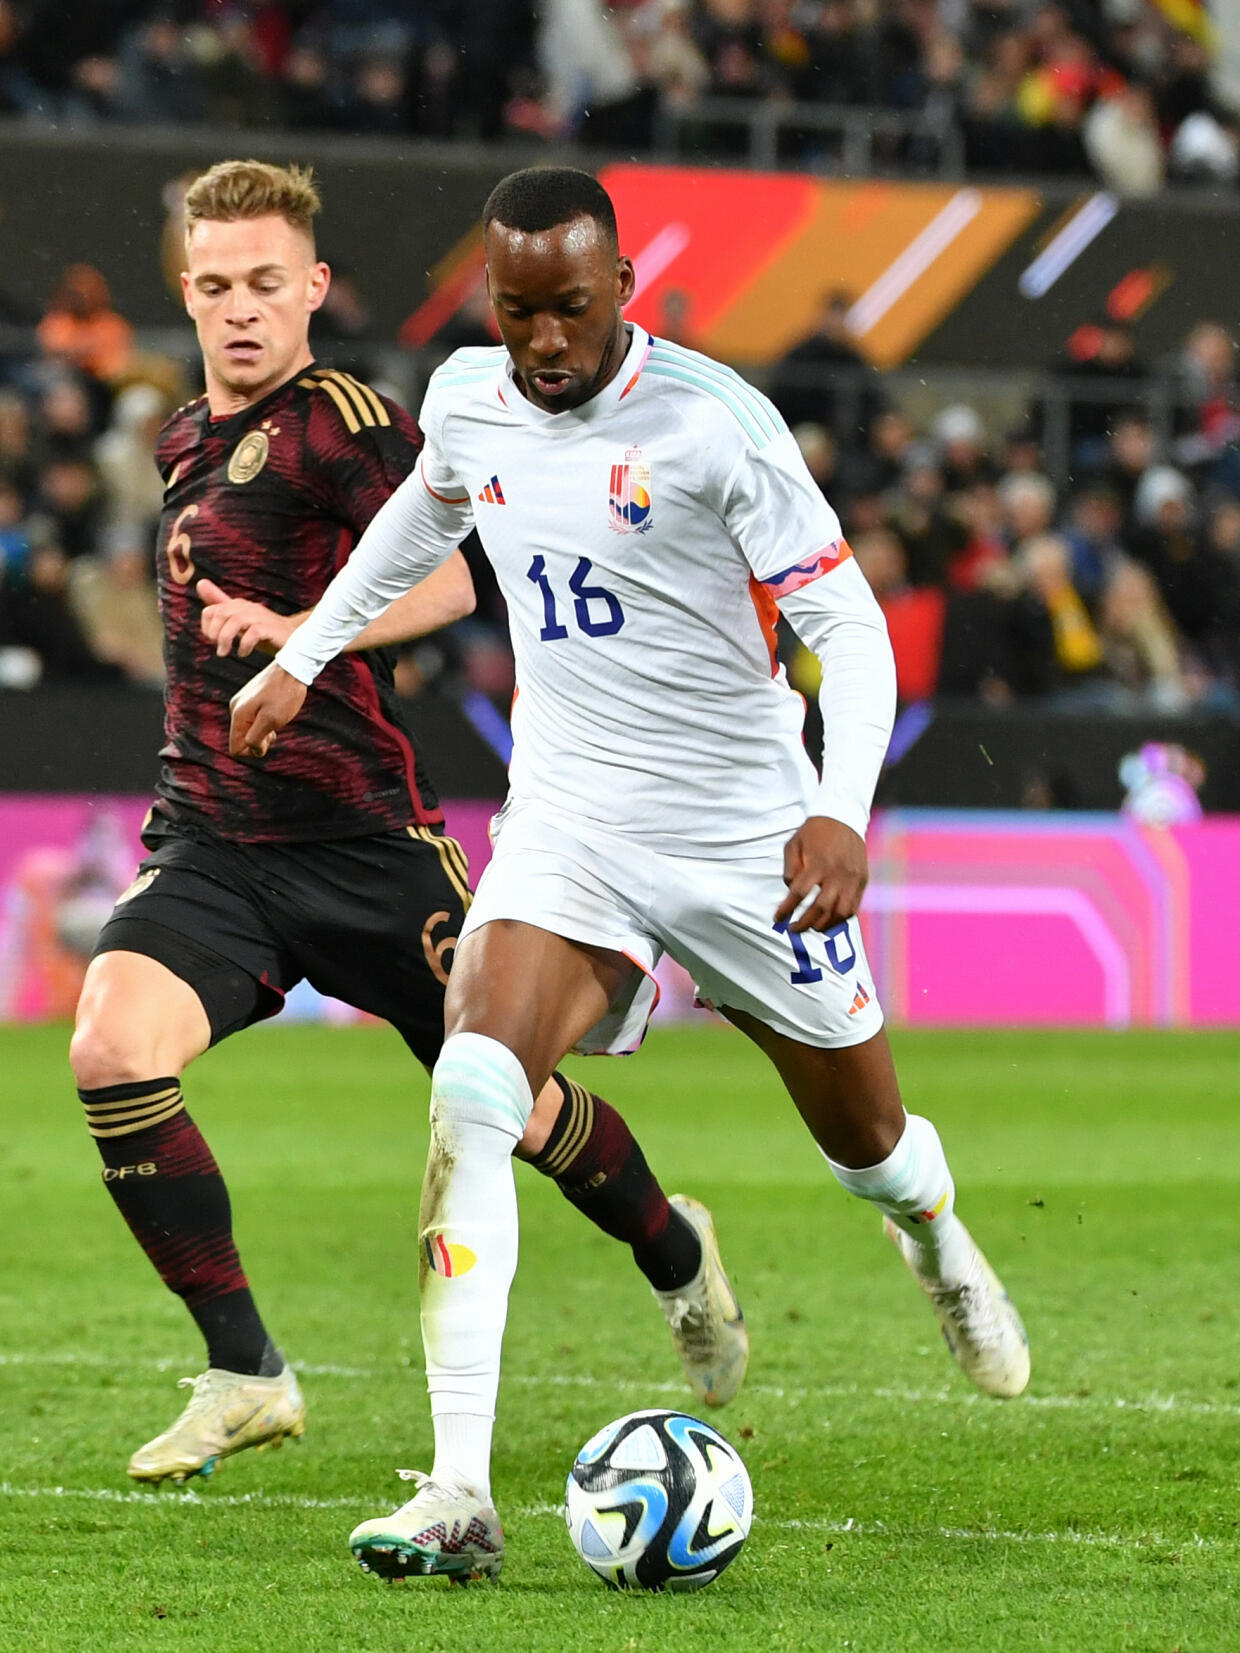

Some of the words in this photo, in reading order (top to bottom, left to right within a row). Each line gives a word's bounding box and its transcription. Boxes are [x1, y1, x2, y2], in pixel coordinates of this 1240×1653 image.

[167, 504, 199, 584] 6
[527, 555, 625, 641] 16
[421, 911, 458, 986] 6
[102, 1162, 158, 1182] DFB
